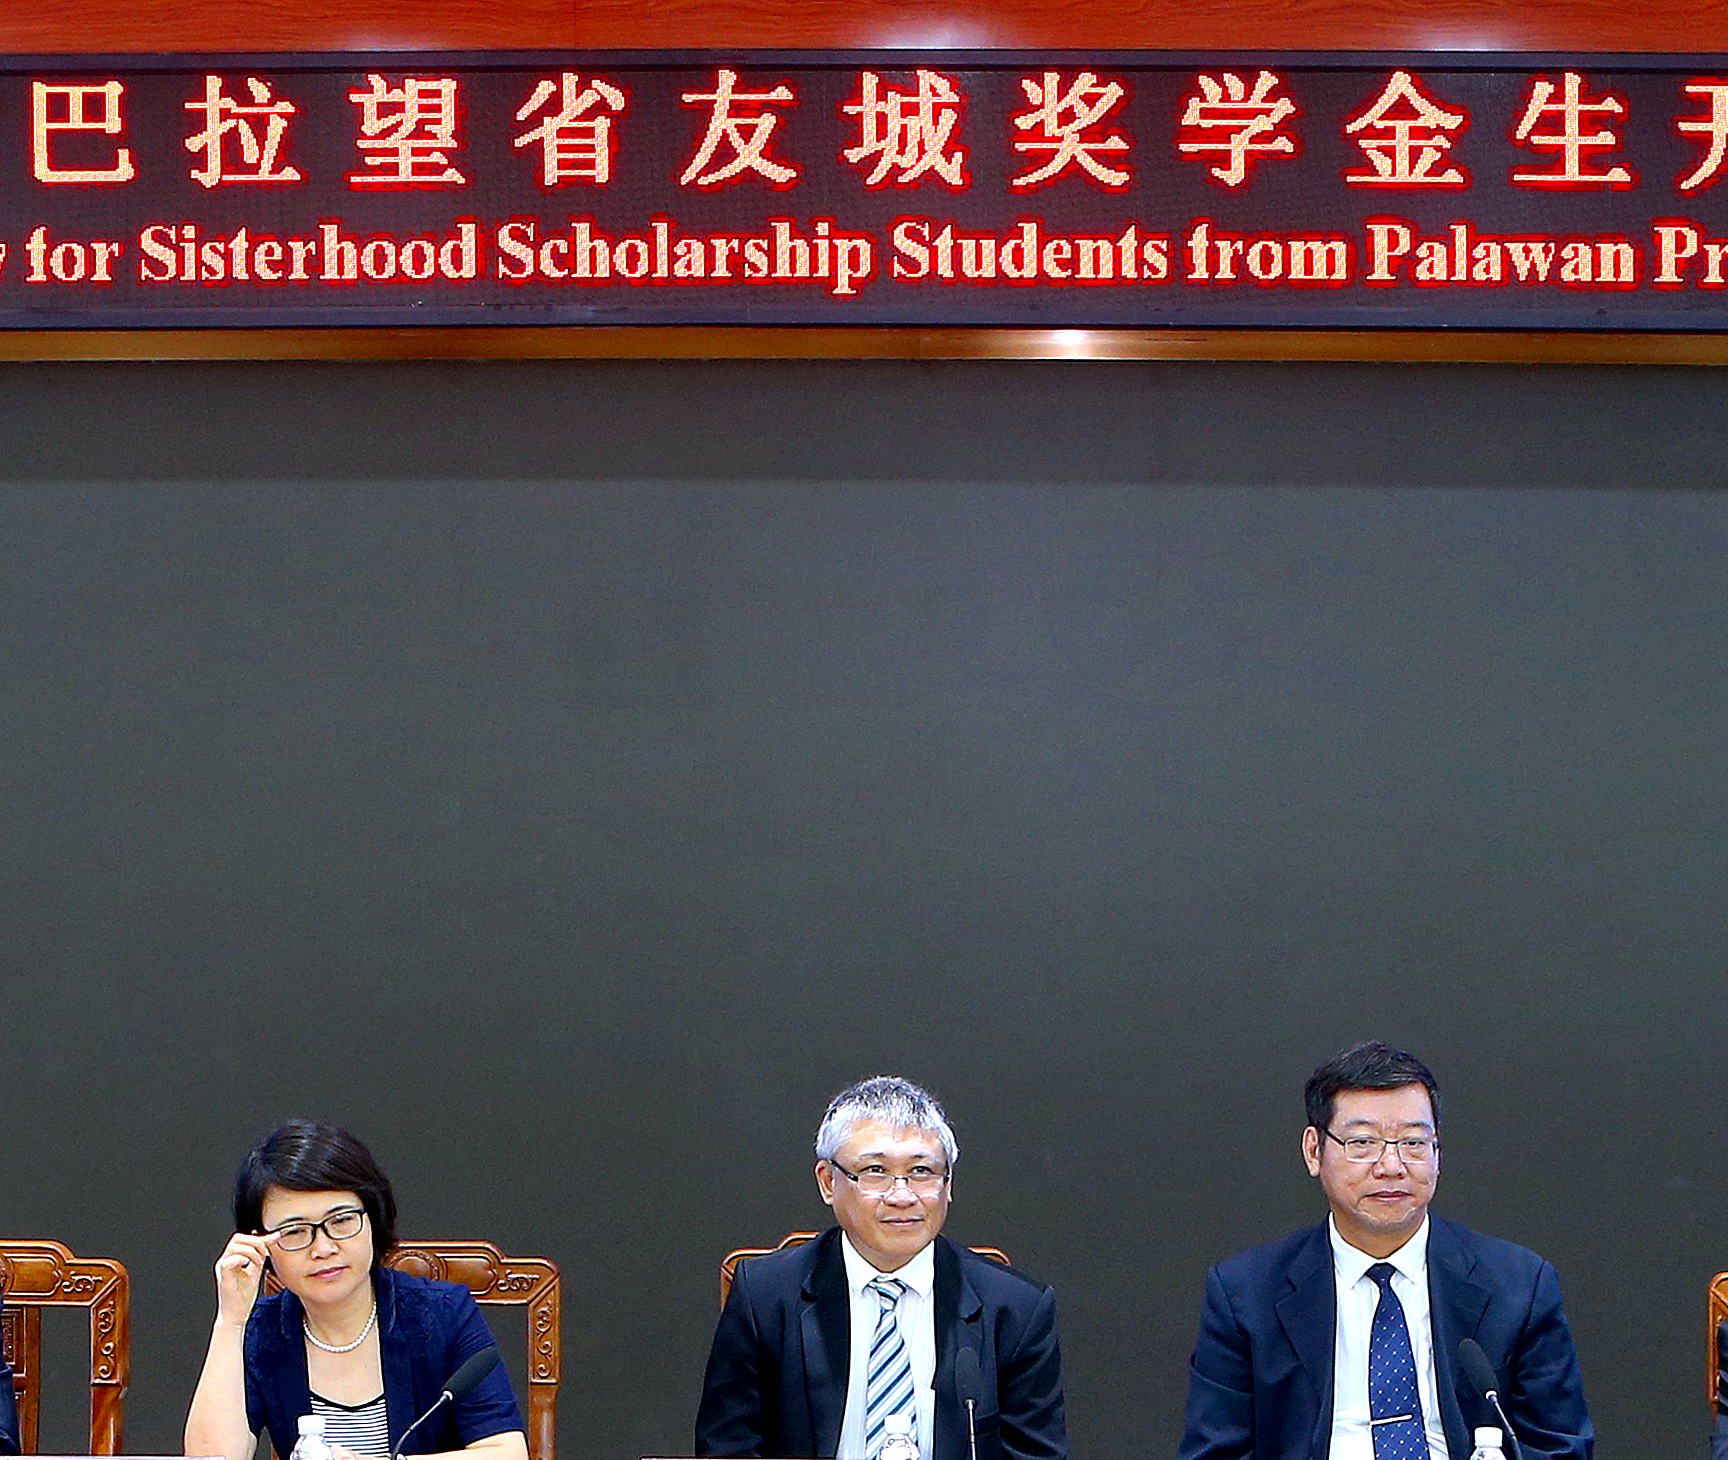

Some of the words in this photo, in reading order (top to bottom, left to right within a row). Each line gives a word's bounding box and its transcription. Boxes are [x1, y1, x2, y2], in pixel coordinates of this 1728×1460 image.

[25, 226, 119, 282] for
[140, 223, 476, 281] Sisterhood
[498, 222, 871, 294] Scholarship
[893, 222, 1168, 280] Students
[1187, 223, 1347, 281] from
[1366, 224, 1634, 282] Palawan
